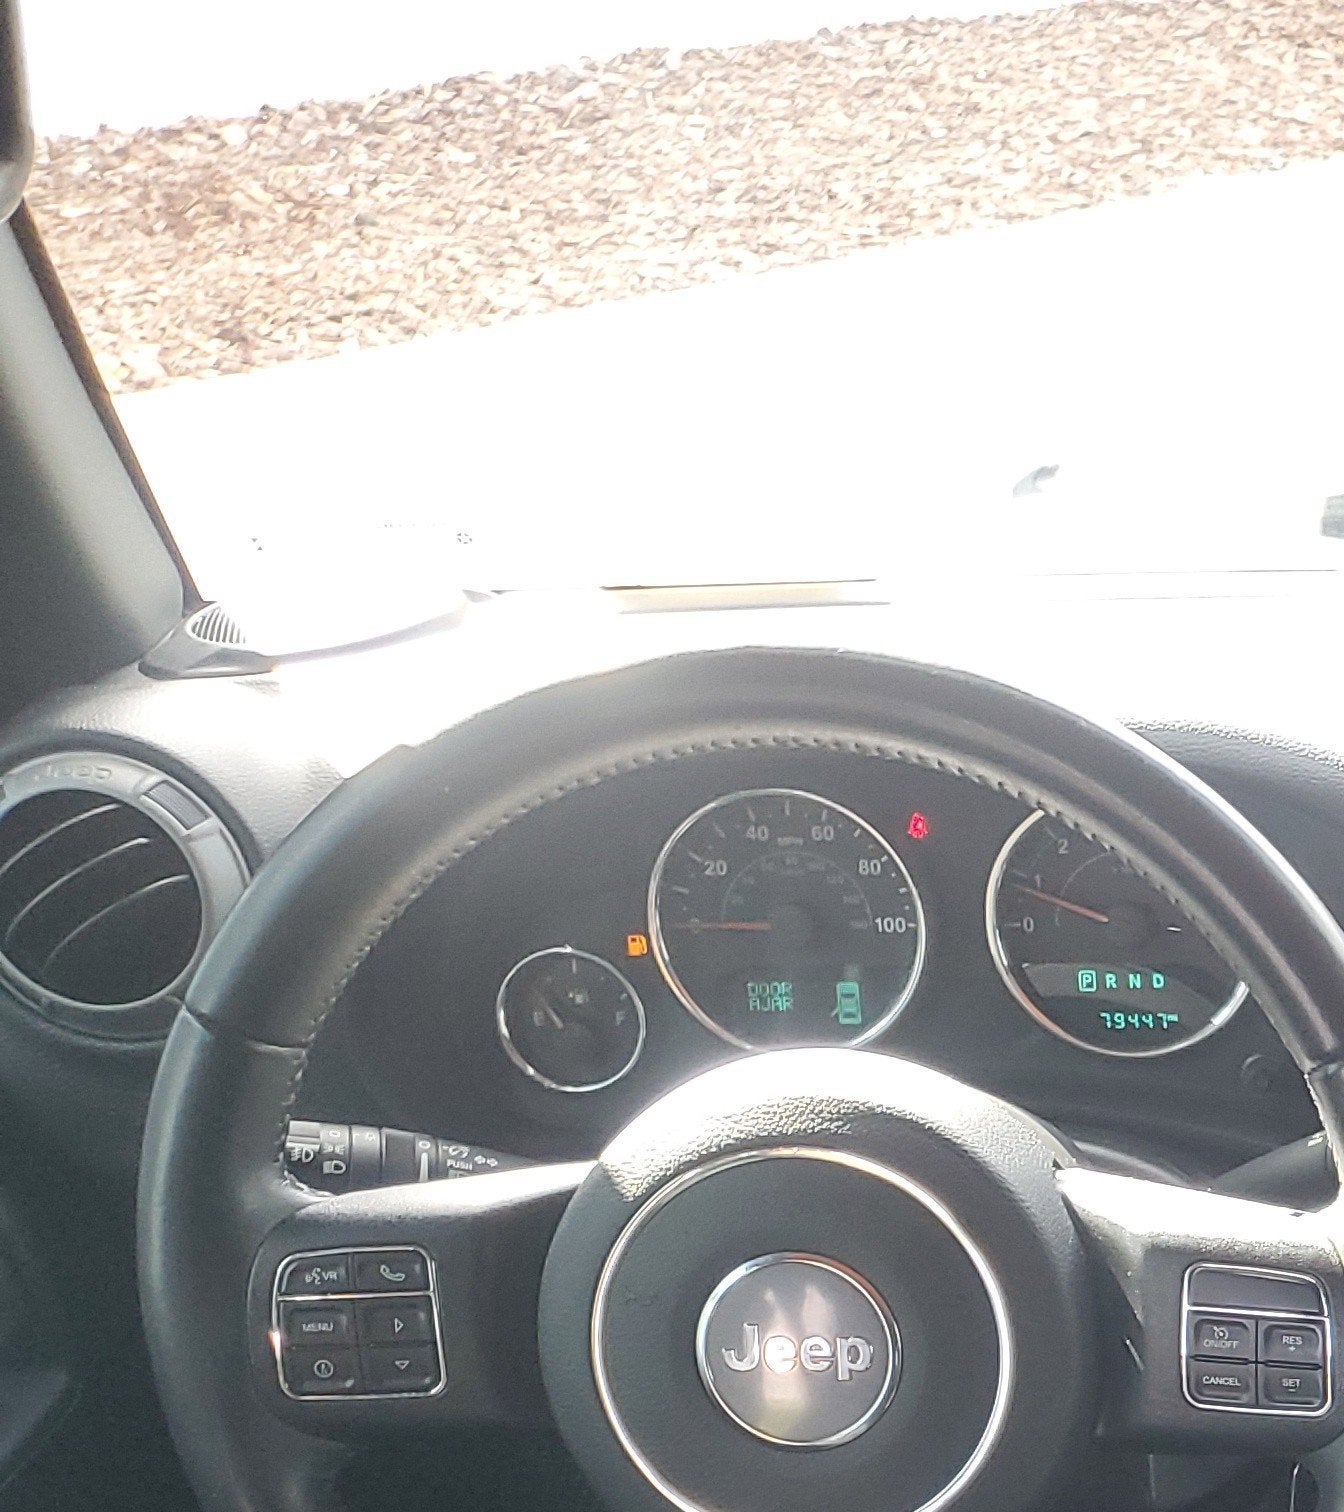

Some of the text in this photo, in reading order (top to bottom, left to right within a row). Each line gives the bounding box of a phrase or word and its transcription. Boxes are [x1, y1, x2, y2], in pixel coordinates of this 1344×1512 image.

[746, 825, 769, 841] 40
[811, 825, 834, 841] 60
[704, 860, 727, 876] 20
[858, 859, 881, 875] 80
[874, 917, 906, 933] 100
[1023, 917, 1034, 932] 0
[747, 981, 793, 997] DOOR
[1082, 973, 1164, 989] P R N D
[749, 997, 794, 1011] AJAR
[1099, 1012, 1168, 1029] 79447
[1282, 1335, 1303, 1345] RES
[722, 1322, 874, 1382] Jeep
[1203, 1375, 1241, 1387] CANCEL
[1282, 1378, 1301, 1388] SET
